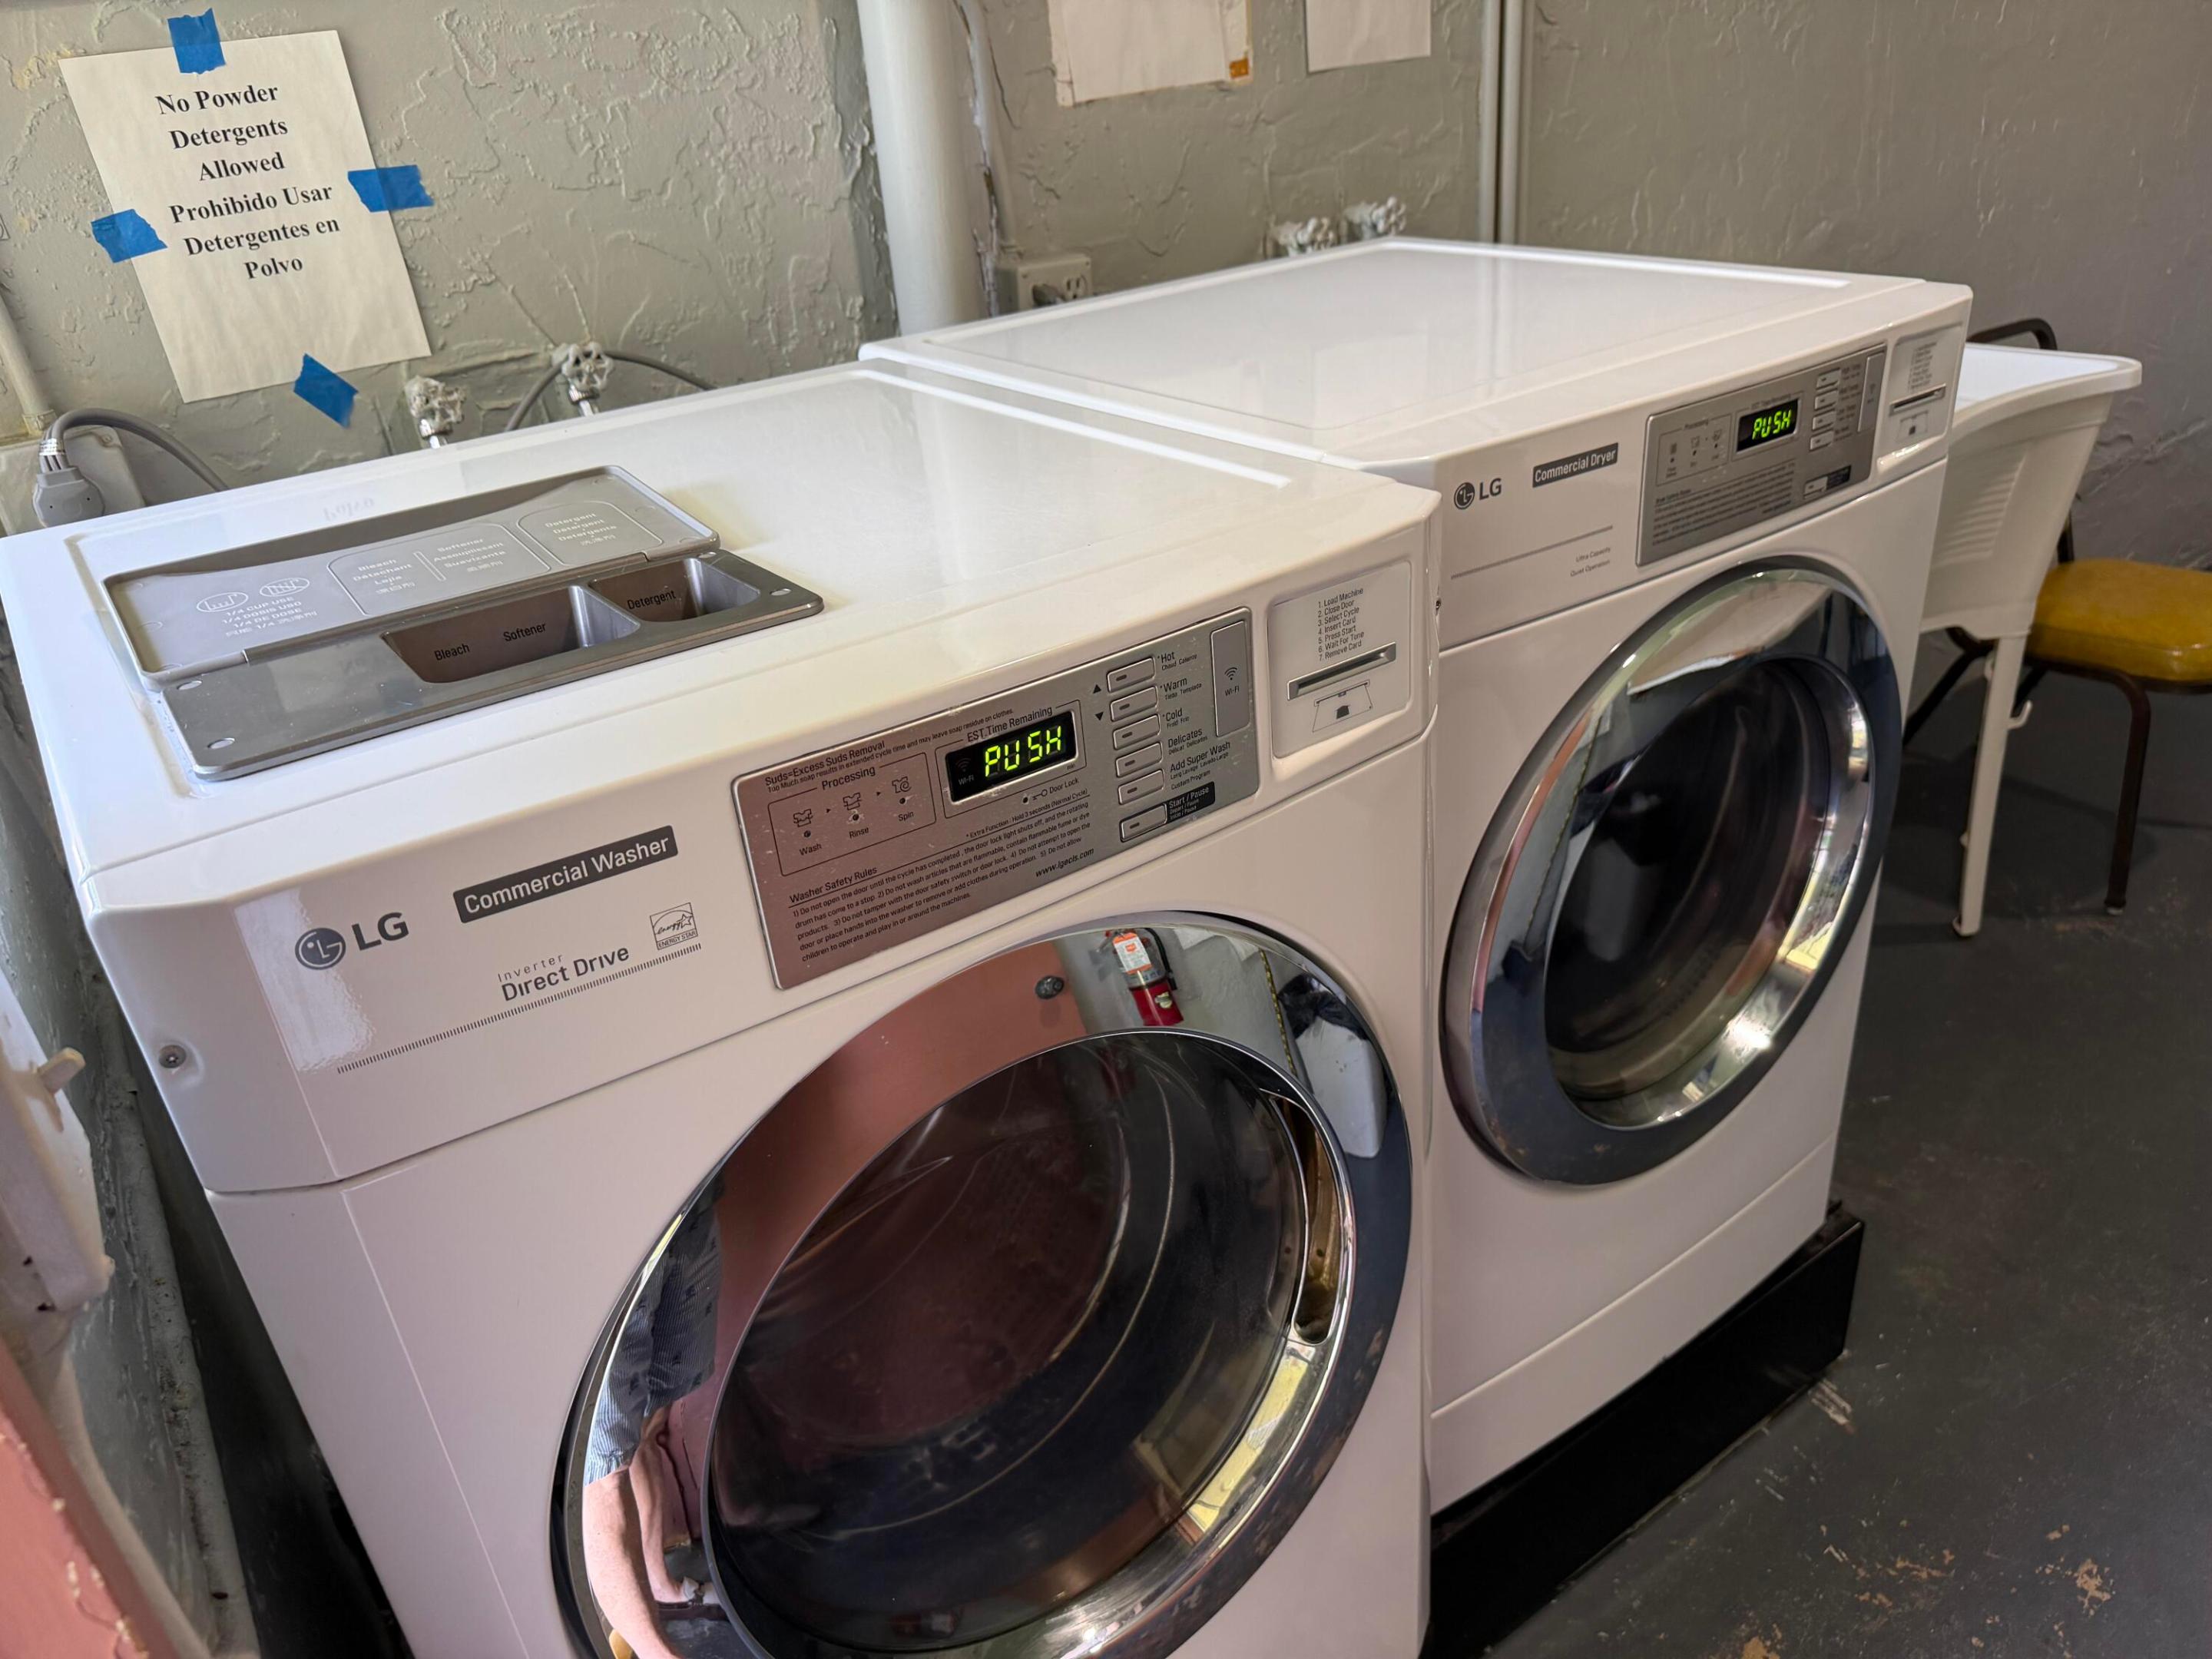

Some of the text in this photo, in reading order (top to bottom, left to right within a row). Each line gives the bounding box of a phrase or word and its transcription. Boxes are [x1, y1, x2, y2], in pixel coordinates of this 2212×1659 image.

[155, 84, 277, 114] No Powder
[171, 121, 287, 148] Detergents
[200, 151, 284, 180] Allowed
[171, 186, 332, 223] Prohibido Usar
[184, 220, 339, 254] Detergentes en
[245, 257, 303, 278] Polvo
[1752, 409, 1792, 440] PUSH
[1535, 449, 1616, 482] Commercial Dryer
[1479, 478, 1502, 500] LG
[627, 589, 677, 610] Detergent
[1323, 595, 1338, 606] Load
[1339, 588, 1363, 601] Machine
[1324, 604, 1339, 615] Close
[1340, 599, 1354, 610] Door
[1324, 612, 1342, 624] Select
[1343, 607, 1359, 618] Cycle
[1324, 621, 1341, 633] Insert
[1343, 615, 1356, 627] Card
[503, 623, 547, 642] Softener
[1325, 631, 1340, 641] Press
[1342, 624, 1356, 636] Start
[1325, 640, 1339, 650] Wait
[1350, 631, 1364, 641] Tone
[434, 643, 470, 661] Bleach
[1161, 651, 1174, 663] Hot
[1325, 646, 1347, 659] Remove
[1348, 639, 1361, 651] Card
[1164, 677, 1187, 692] Warm
[1225, 685, 1239, 696] Wi-Fi
[1008, 707, 1052, 727] Remaining
[1165, 707, 1182, 721] Cold
[1167, 728, 1202, 747] Delicates
[825, 753, 847, 767] Suds
[849, 740, 885, 759] Removal
[985, 727, 1061, 776] PUSH
[1170, 741, 1230, 772] Add Super Wash
[821, 767, 876, 790] Processing
[1049, 777, 1078, 793] Door Lock
[1169, 796, 1184, 808] Start
[1190, 786, 1209, 799] Pause
[898, 811, 914, 821] Spin
[849, 826, 869, 839] Rinse
[799, 843, 822, 856] Wash
[464, 837, 671, 915] Commercial Washer
[790, 867, 877, 902] Washer Safety Rules
[352, 912, 409, 951] LG
[658, 930, 696, 948] ENERGY STAR
[498, 953, 565, 983] Inverter
[501, 946, 630, 1002] Direct Drive
